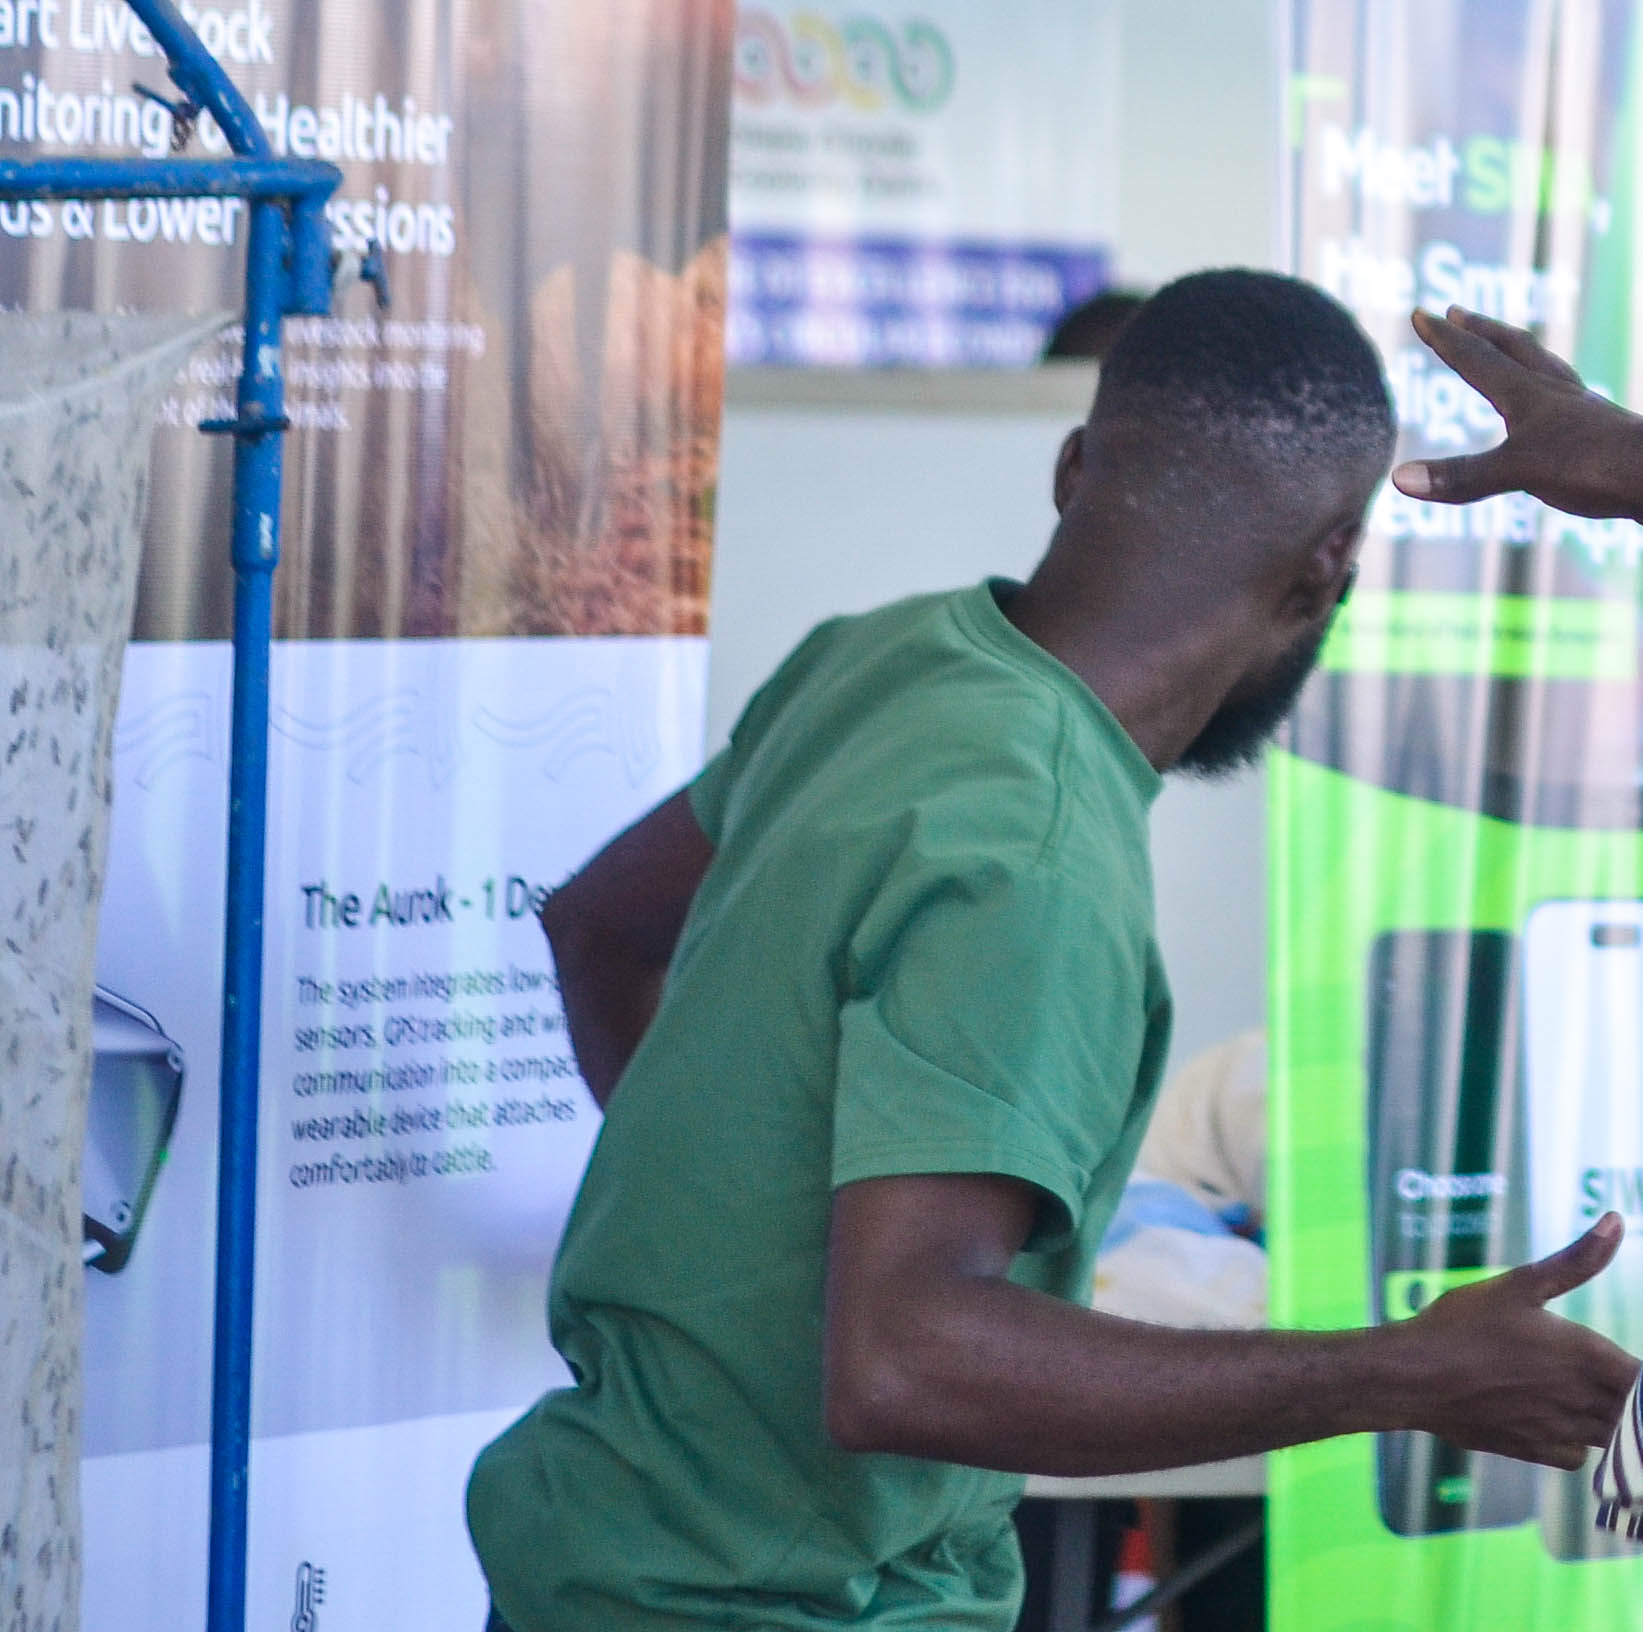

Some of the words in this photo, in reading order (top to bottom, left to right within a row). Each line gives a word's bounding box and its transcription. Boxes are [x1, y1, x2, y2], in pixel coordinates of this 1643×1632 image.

[0, 71, 172, 160] nitoring
[255, 91, 454, 166] Healthier
[1320, 123, 1458, 208] Meet
[325, 183, 456, 258] ssions
[301, 880, 361, 931] The
[370, 874, 454, 926] Aurok
[482, 876, 496, 922] 1
[296, 973, 333, 1007] The
[336, 973, 408, 1011] system
[410, 969, 506, 1004] integrates
[420, 1010, 497, 1046] tracking
[500, 1006, 535, 1039] and
[292, 1061, 436, 1099] communication
[439, 1054, 482, 1087] into
[499, 1053, 582, 1084] compac
[290, 1104, 388, 1143] wearable
[390, 1102, 444, 1139] device
[446, 1097, 491, 1131] that
[493, 1093, 577, 1129] attaches
[289, 1148, 409, 1192] comfortably
